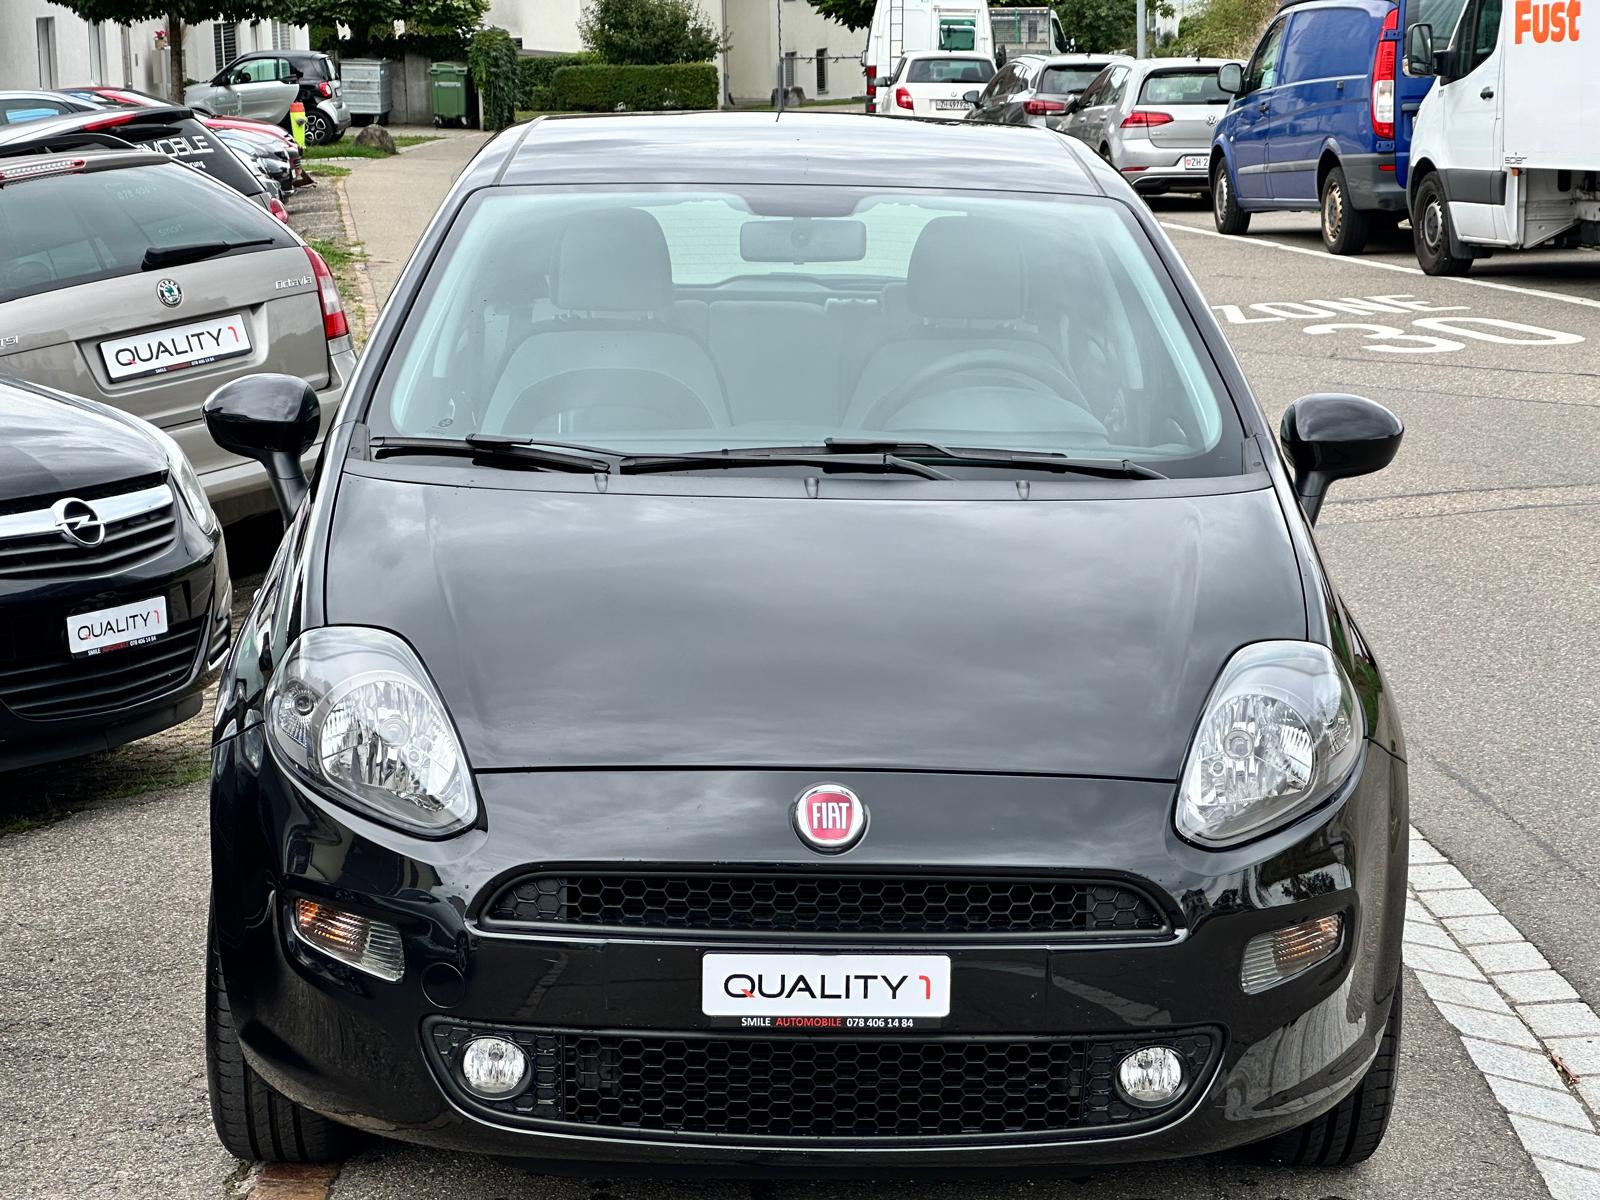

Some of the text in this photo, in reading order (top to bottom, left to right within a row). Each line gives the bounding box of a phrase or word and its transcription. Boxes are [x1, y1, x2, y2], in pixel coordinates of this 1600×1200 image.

[275, 275, 312, 289] Octavia
[1211, 294, 1471, 324] ZONE
[115, 326, 239, 367] QUALITY 1
[1302, 317, 1586, 353] 30
[78, 610, 160, 640] QUALITY 1
[812, 802, 850, 830] FIAT
[723, 973, 931, 1000] QUALITY 1
[741, 1017, 914, 1028] SMILE AUTOMOBILE 078 406 14 84
